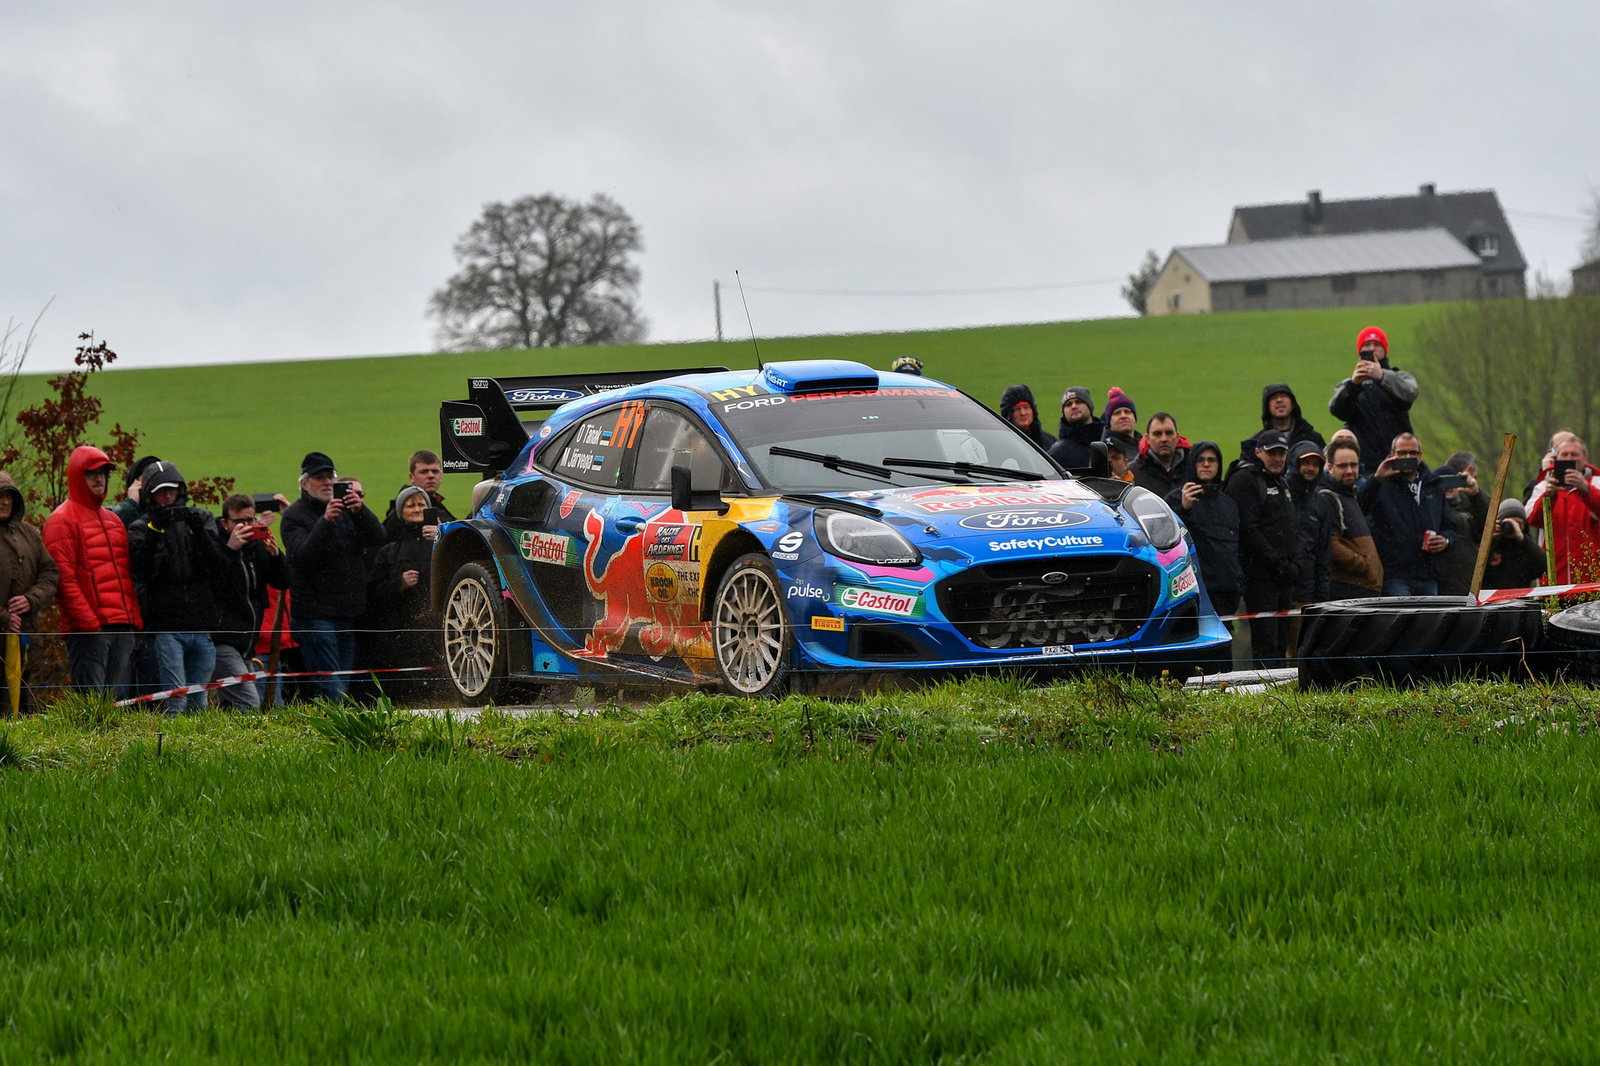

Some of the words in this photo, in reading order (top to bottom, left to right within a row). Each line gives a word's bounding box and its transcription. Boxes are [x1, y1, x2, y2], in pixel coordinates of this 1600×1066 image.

[512, 390, 570, 401] Ford
[710, 384, 760, 402] HY
[789, 389, 962, 404] PERFORMANCE
[724, 396, 786, 413] FORD
[460, 418, 481, 435] Castrol
[609, 401, 646, 448] HY
[583, 424, 602, 446] Tänak
[918, 496, 997, 513] Red
[998, 494, 1071, 508] Bull
[985, 511, 1069, 528] Ford
[531, 535, 565, 561] Castrol
[988, 534, 1103, 552] SafetyCulture
[677, 570, 688, 581] THE
[787, 583, 823, 599] pulse
[858, 592, 912, 613] Castrol
